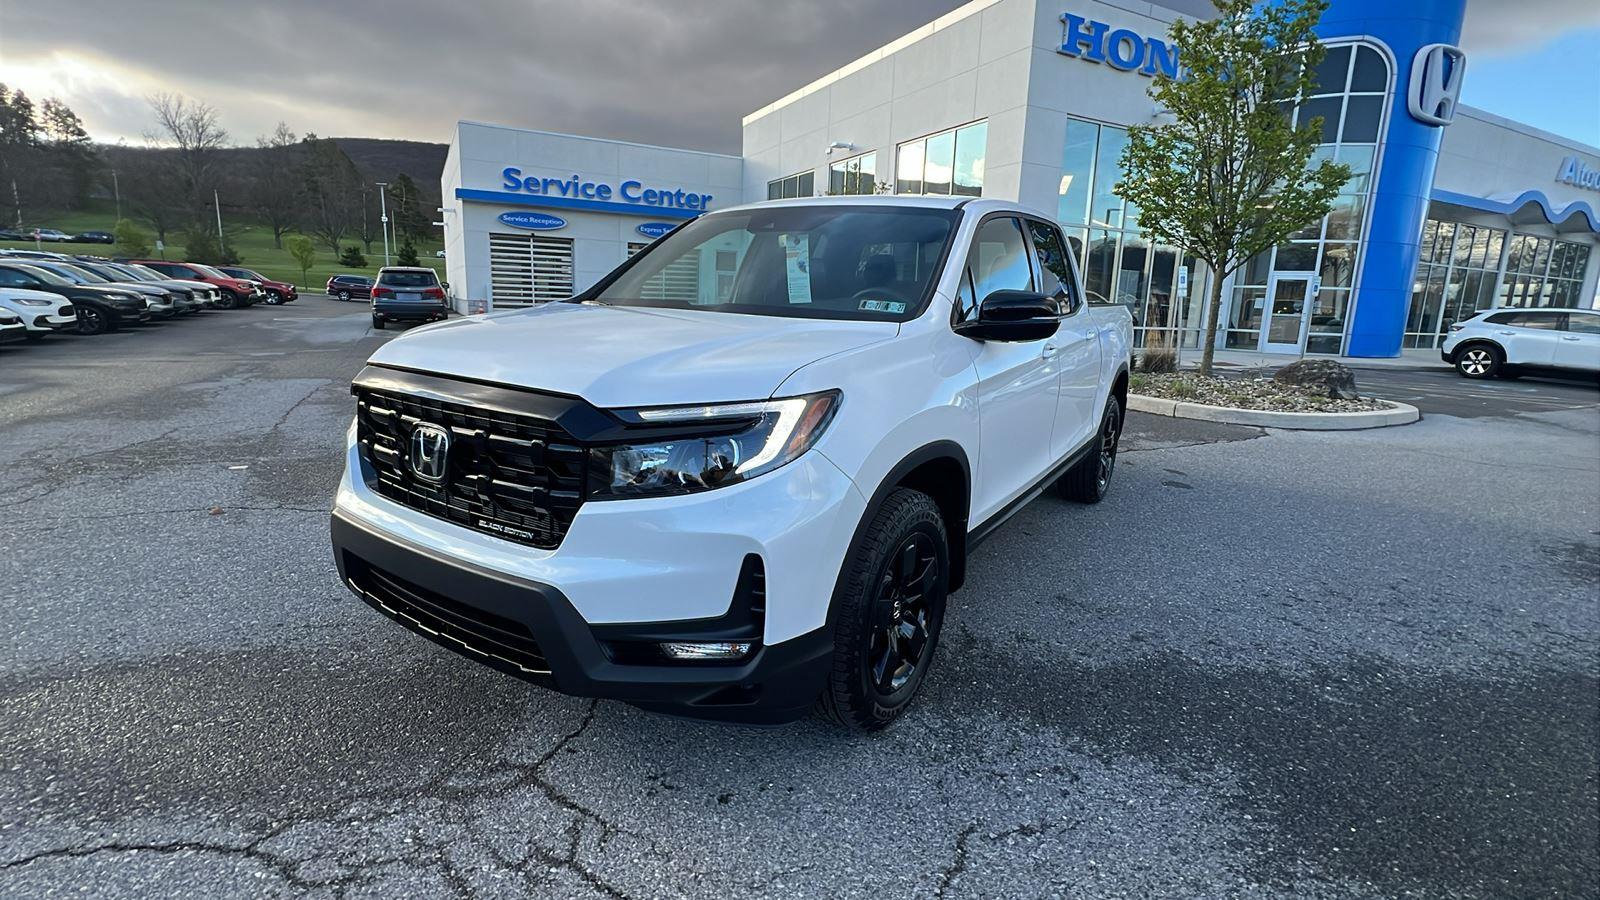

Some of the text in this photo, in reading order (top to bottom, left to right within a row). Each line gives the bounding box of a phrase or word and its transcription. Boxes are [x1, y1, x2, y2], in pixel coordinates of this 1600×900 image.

[1057, 12, 1190, 82] HON
[502, 167, 713, 210] Service Center
[502, 214, 563, 226] Service Reception
[640, 226, 662, 234] Express
[478, 519, 534, 539] BLACK EDITION
